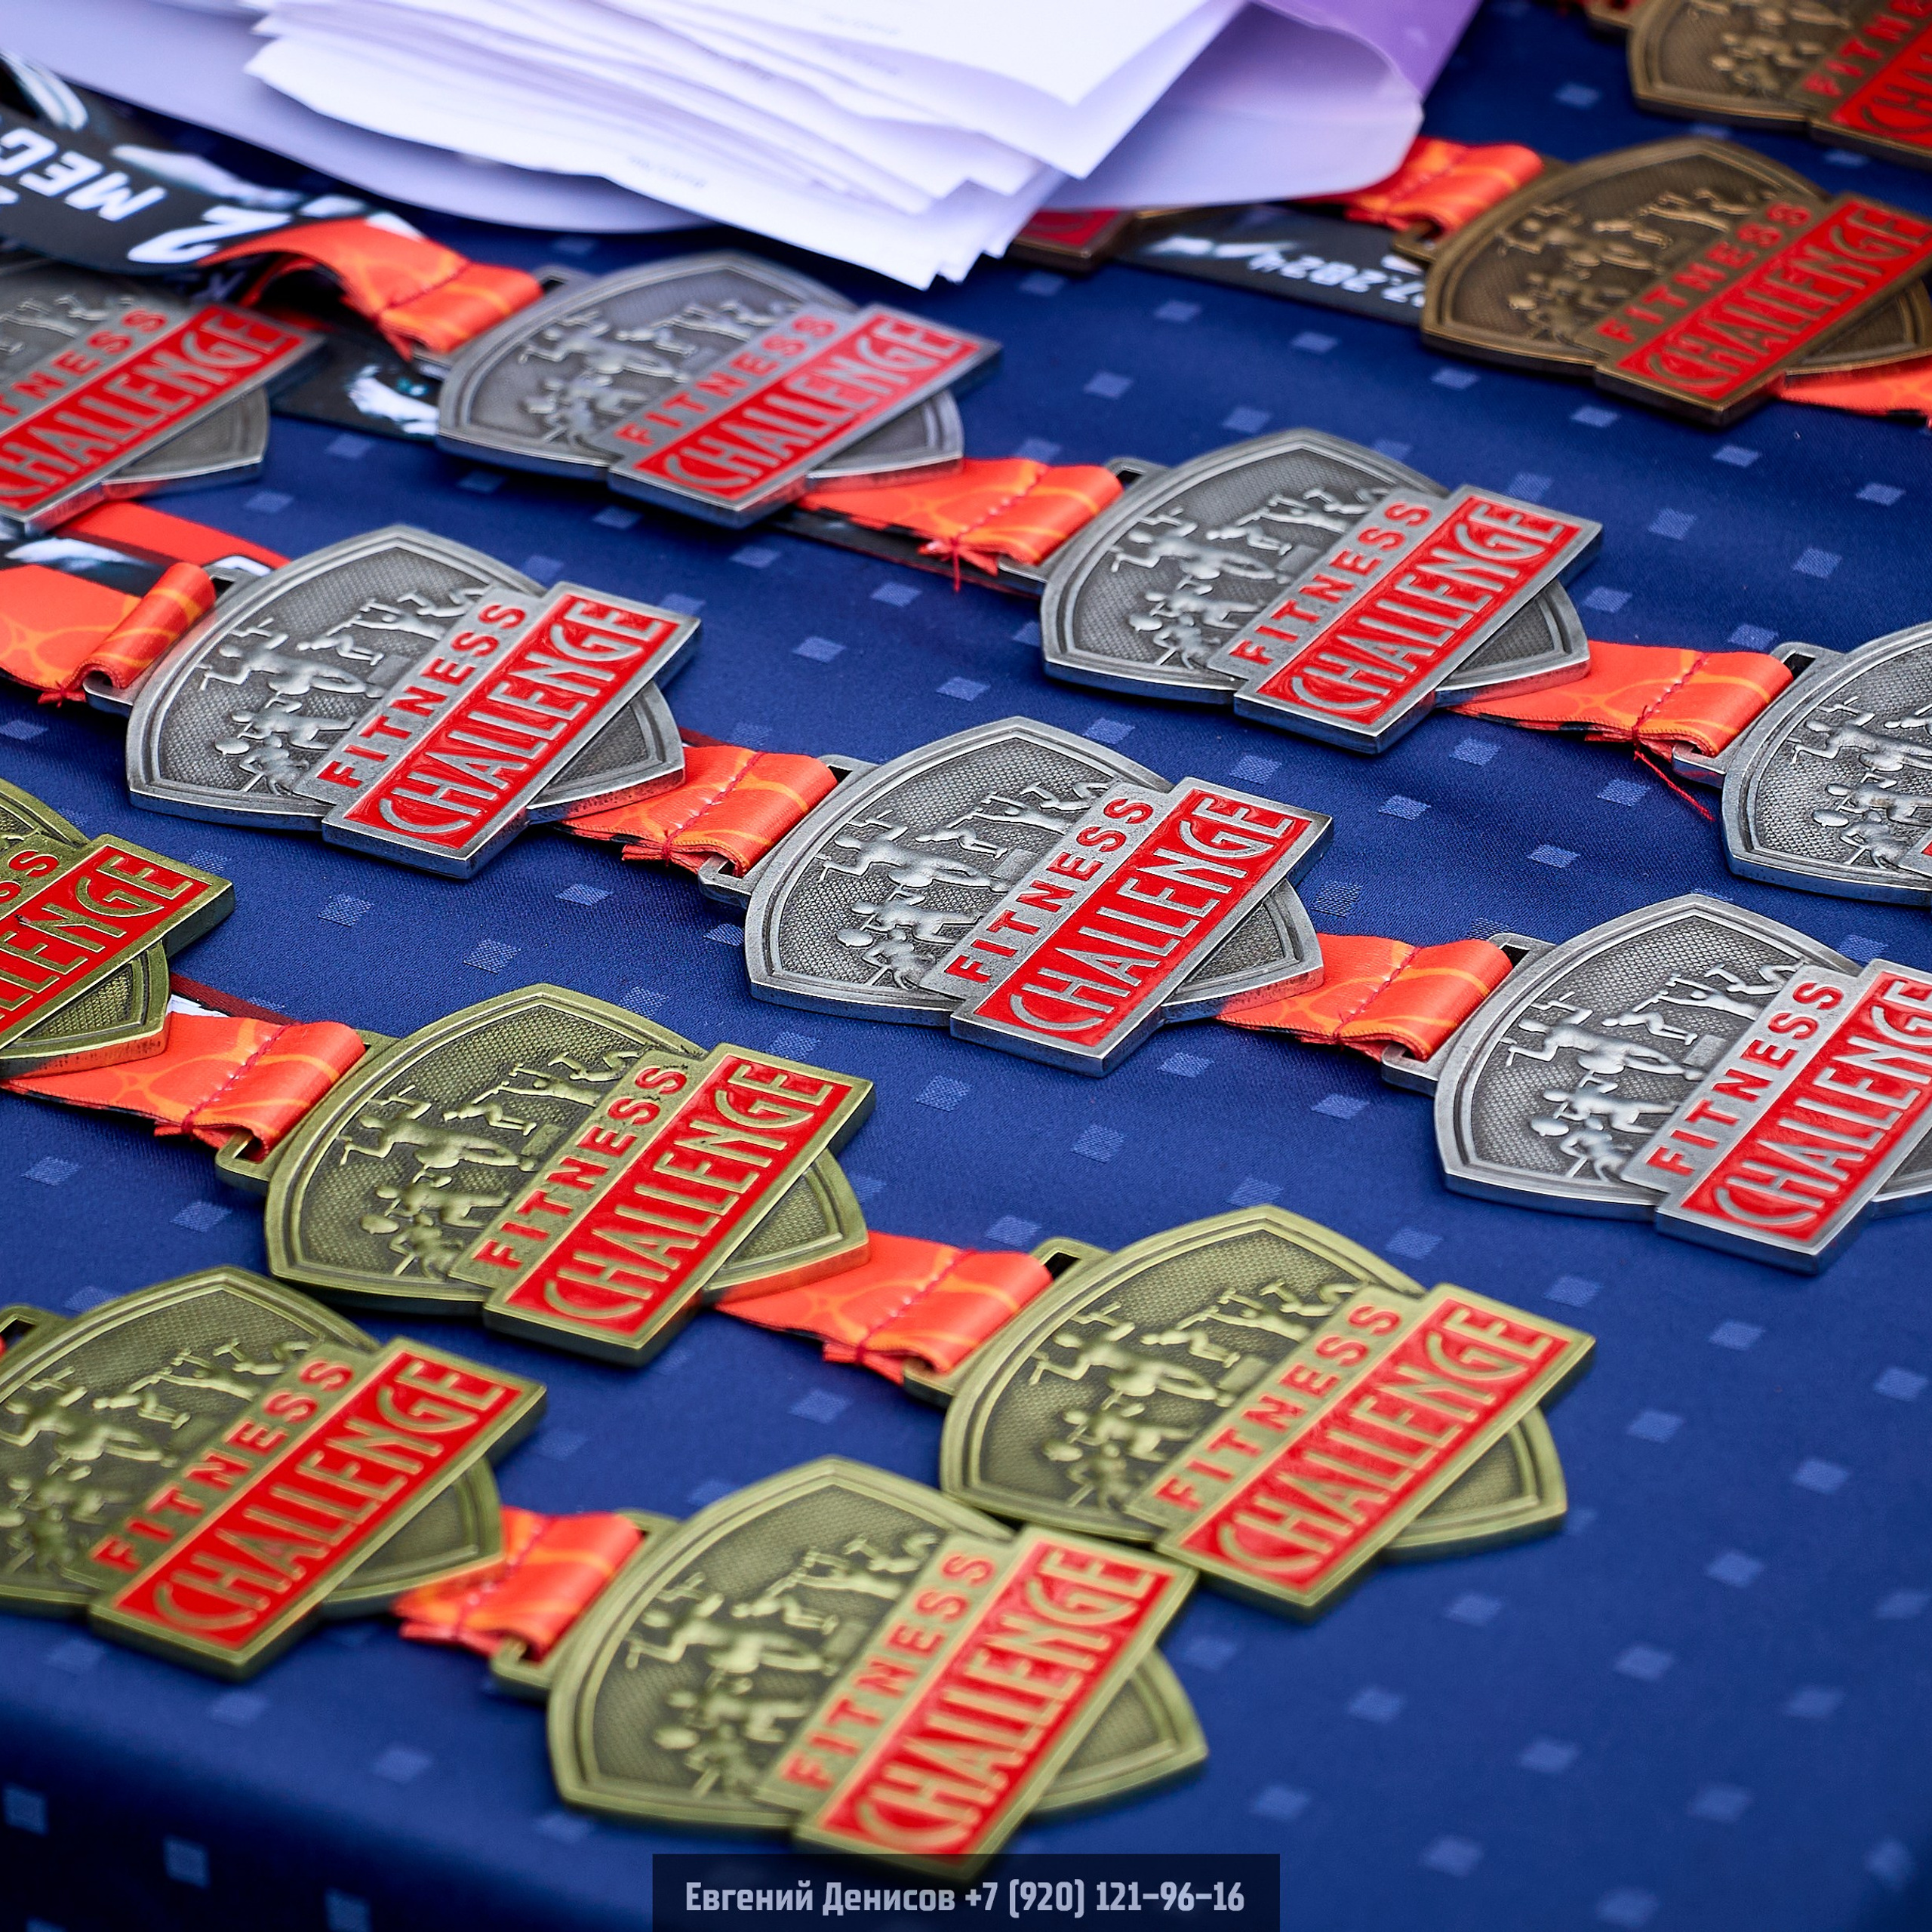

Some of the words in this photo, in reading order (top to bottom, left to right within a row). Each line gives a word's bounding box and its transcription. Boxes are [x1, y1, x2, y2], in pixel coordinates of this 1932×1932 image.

[1596, 202, 1812, 343] FITNESS
[1647, 208, 1932, 386] CHALLENGE
[614, 315, 838, 447] FITNESS
[664, 317, 963, 487] CHALLENGE
[1229, 501, 1432, 666] FITNESS
[1291, 502, 1561, 712] CHALLENGE
[317, 603, 527, 789] FITNESS
[379, 601, 661, 834] CHALLENGE
[944, 797, 1155, 984] FITNESS
[1008, 795, 1294, 1032] CHALLENGE
[472, 1065, 688, 1270] FITNESS
[1645, 982, 1844, 1177] FITNESS
[543, 1064, 834, 1320] CHALLENGE
[90, 1358, 355, 1573] FITNESS
[152, 1360, 507, 1629] CHALLENGE
[1154, 1304, 1403, 1511] FITNESS
[1217, 1306, 1554, 1572] CHALLENGE
[780, 1552, 995, 1791] FITNESS
[858, 1550, 1158, 1850] CHALLENGE
